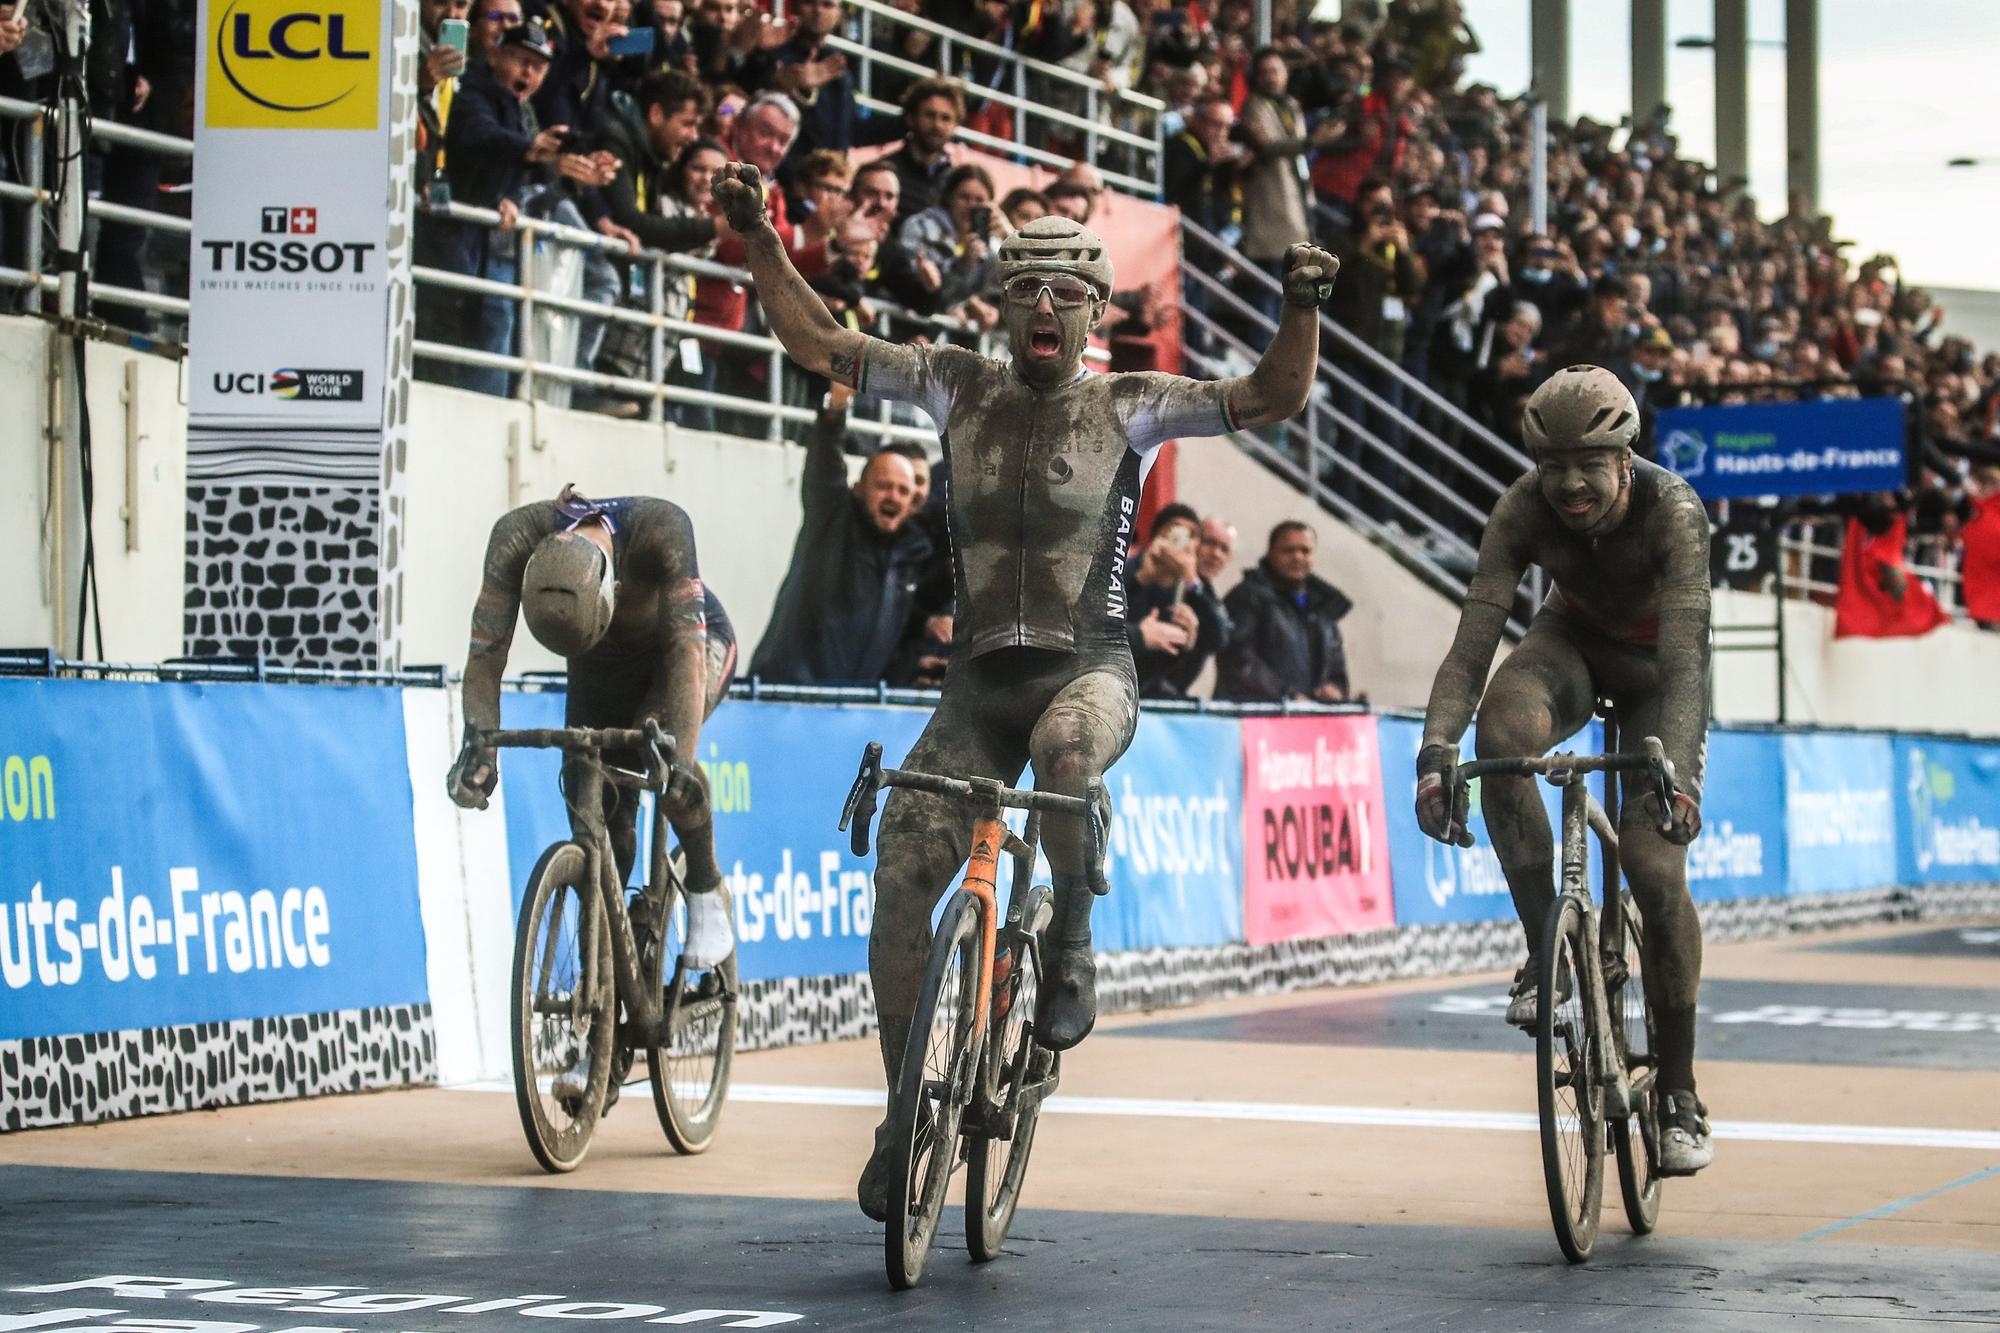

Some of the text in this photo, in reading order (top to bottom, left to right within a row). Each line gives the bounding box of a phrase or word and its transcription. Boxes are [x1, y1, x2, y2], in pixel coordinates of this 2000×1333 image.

[233, 13, 370, 60] LCL
[201, 240, 375, 273] TISSOT
[200, 279, 238, 290] SWISS
[244, 280, 300, 292] WATCHES
[213, 373, 264, 394] UCI
[306, 373, 352, 386] WORLD
[307, 384, 341, 398] TOUR
[1106, 496, 1135, 620] BAHRAIN
